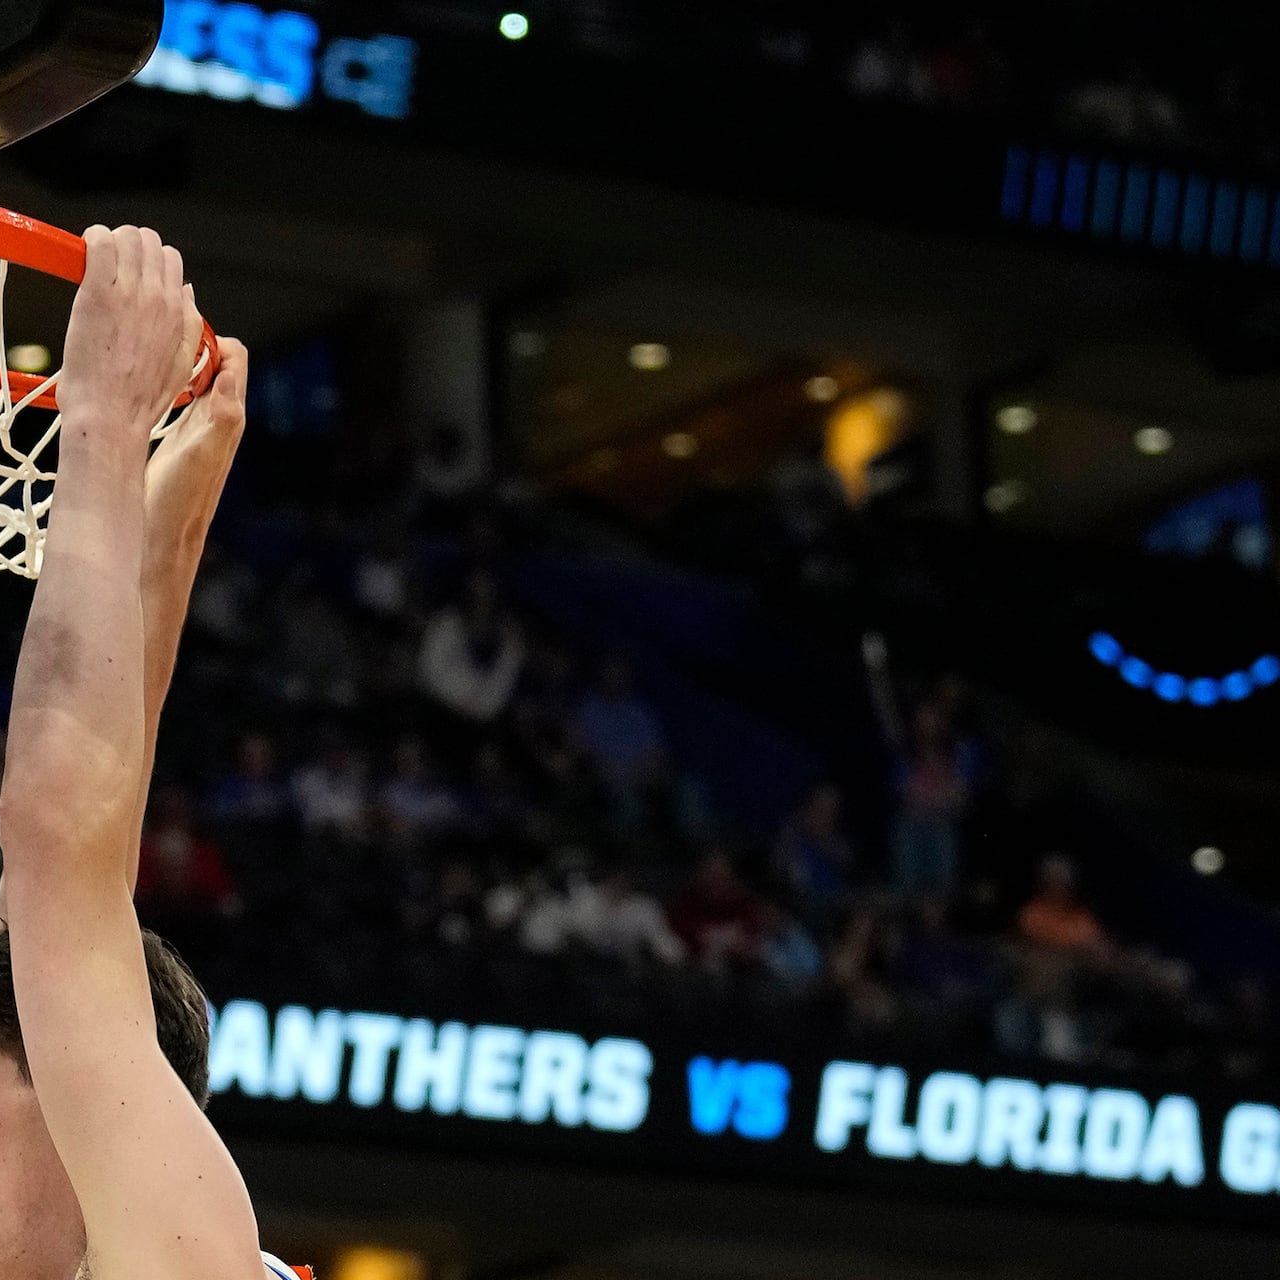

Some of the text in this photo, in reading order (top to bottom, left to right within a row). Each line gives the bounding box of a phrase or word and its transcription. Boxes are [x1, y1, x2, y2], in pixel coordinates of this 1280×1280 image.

[208, 1000, 654, 1133] ANTHERS
[688, 1055, 791, 1140] VS
[815, 1060, 1204, 1187] FLORIDA
